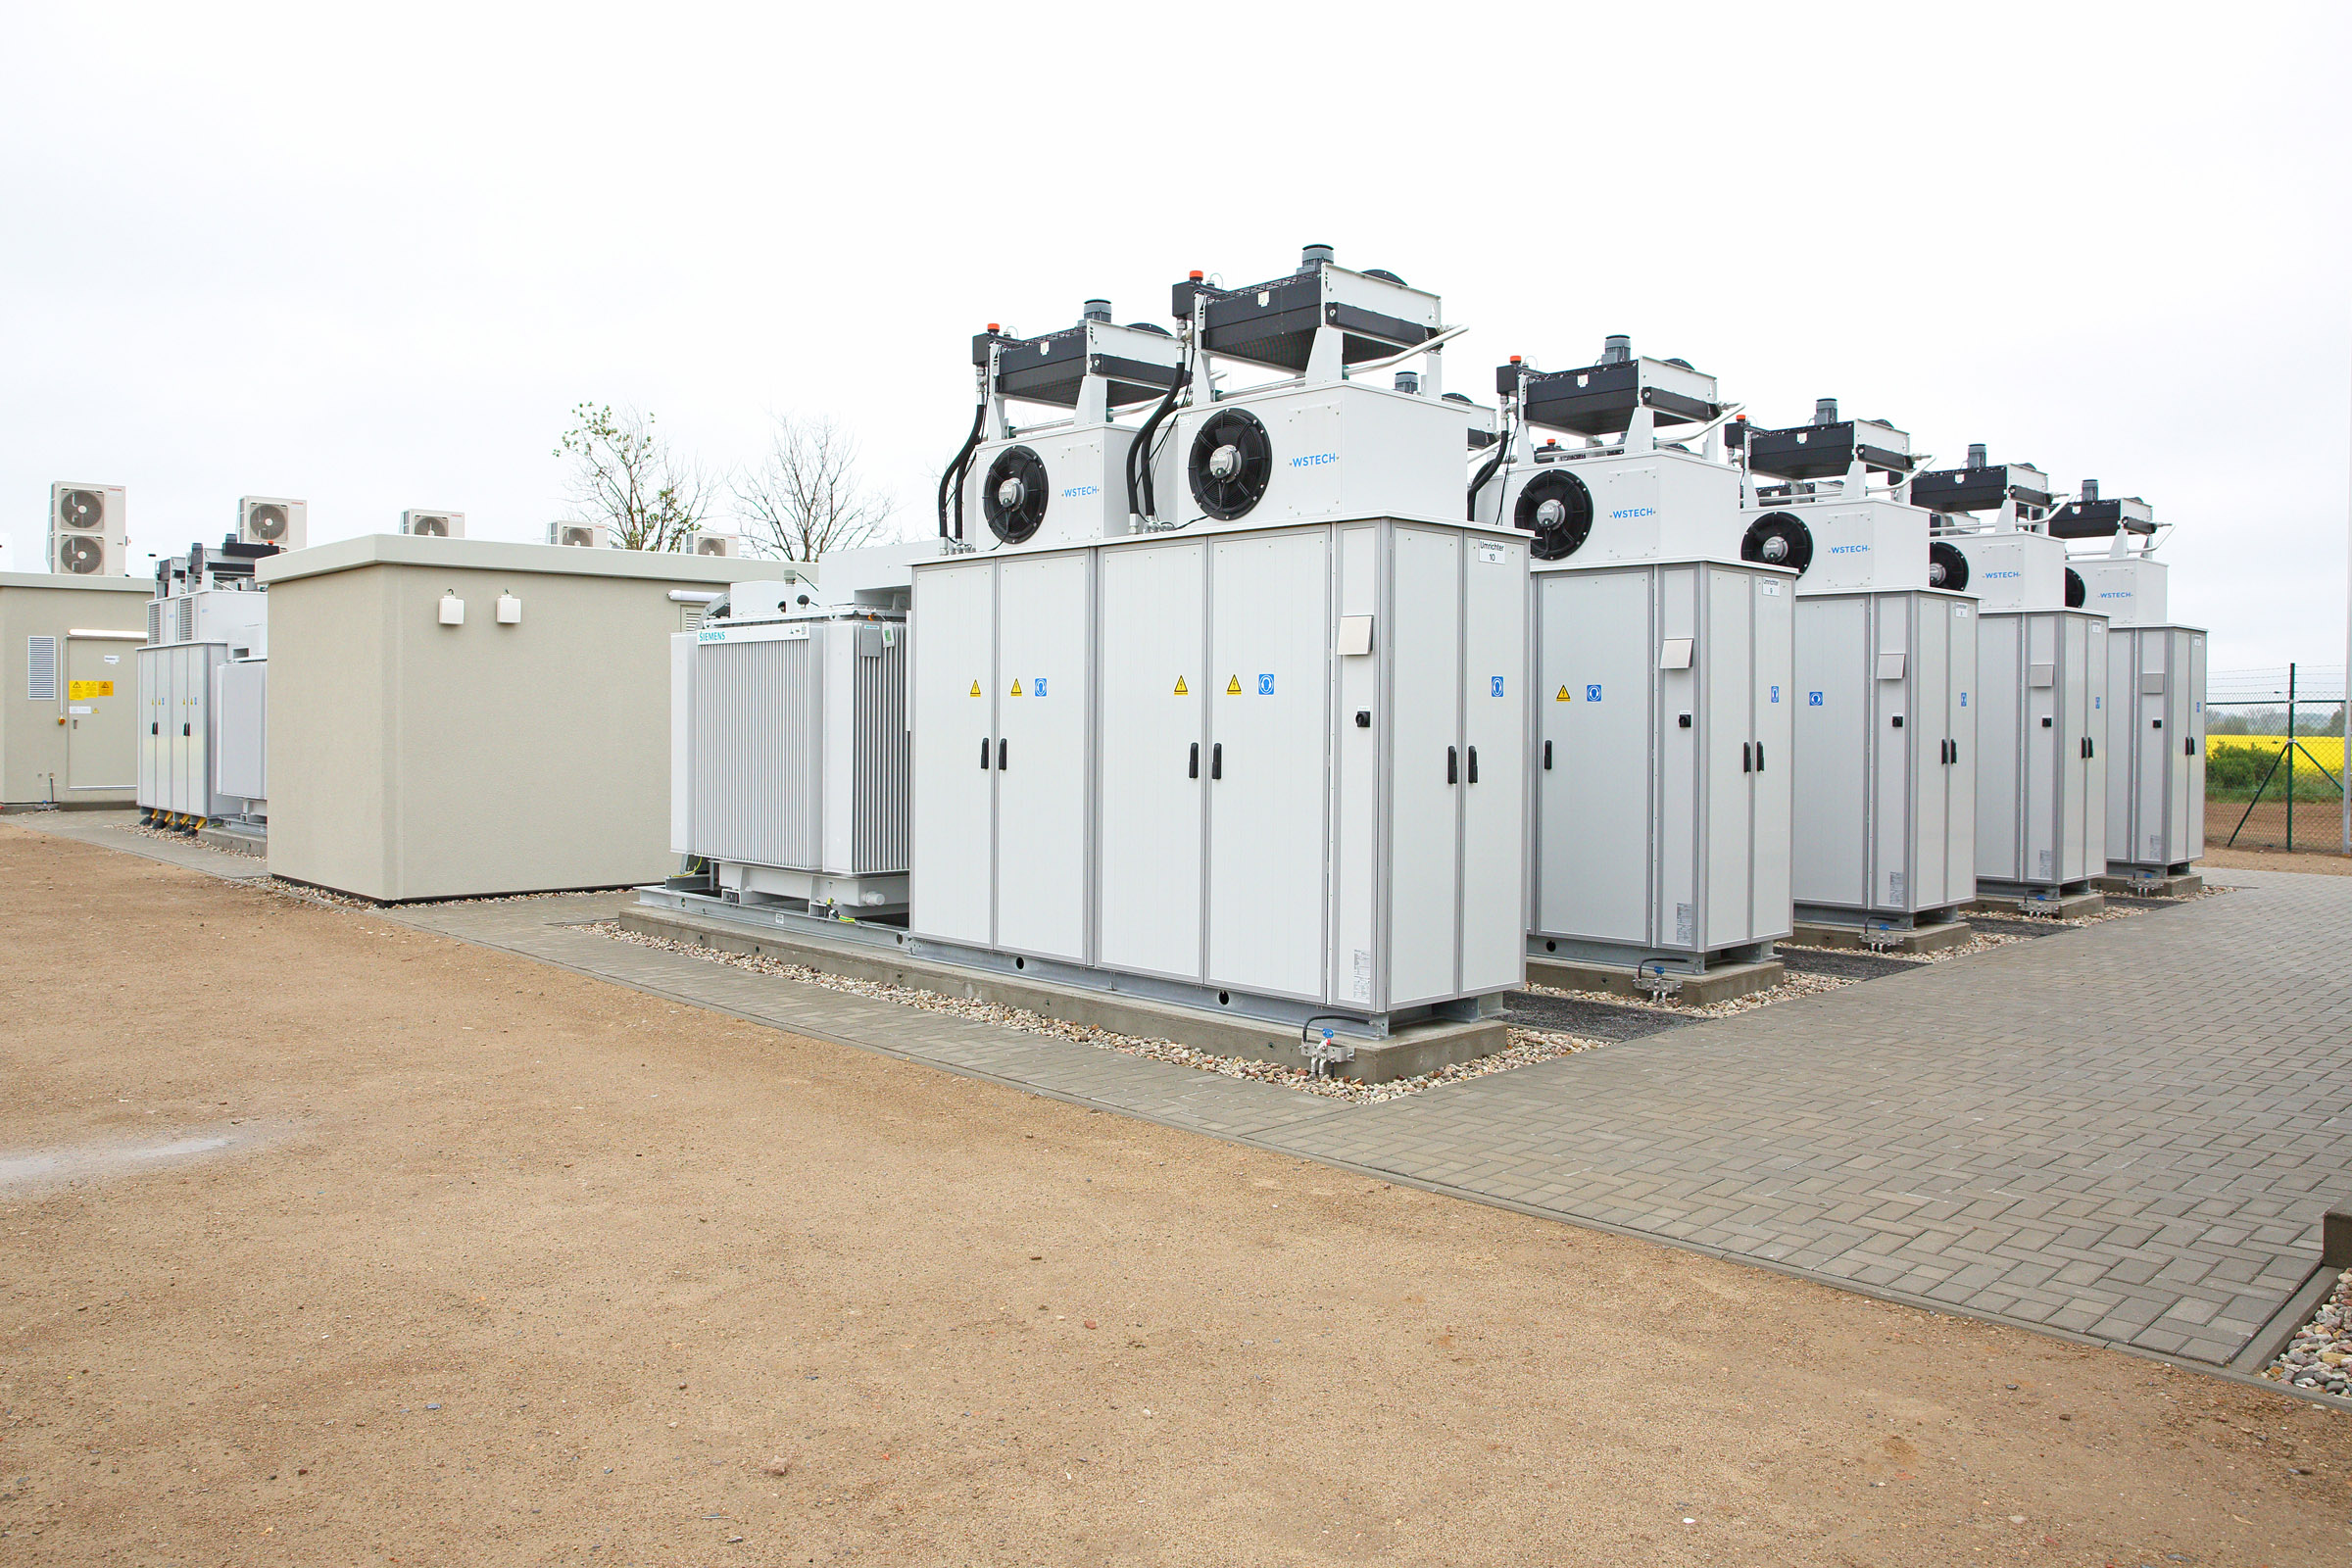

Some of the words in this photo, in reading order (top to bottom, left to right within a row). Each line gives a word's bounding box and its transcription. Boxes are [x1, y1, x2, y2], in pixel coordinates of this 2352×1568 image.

[1293, 453, 1336, 467] WSTECH
[1064, 486, 1097, 498] WSTECH
[1613, 508, 1653, 518] WSTECH
[1480, 541, 1504, 552] Umrichter
[1832, 545, 1868, 554] WSTECH
[1489, 553, 1496, 562] 10
[699, 631, 726, 642] SIEMENS
